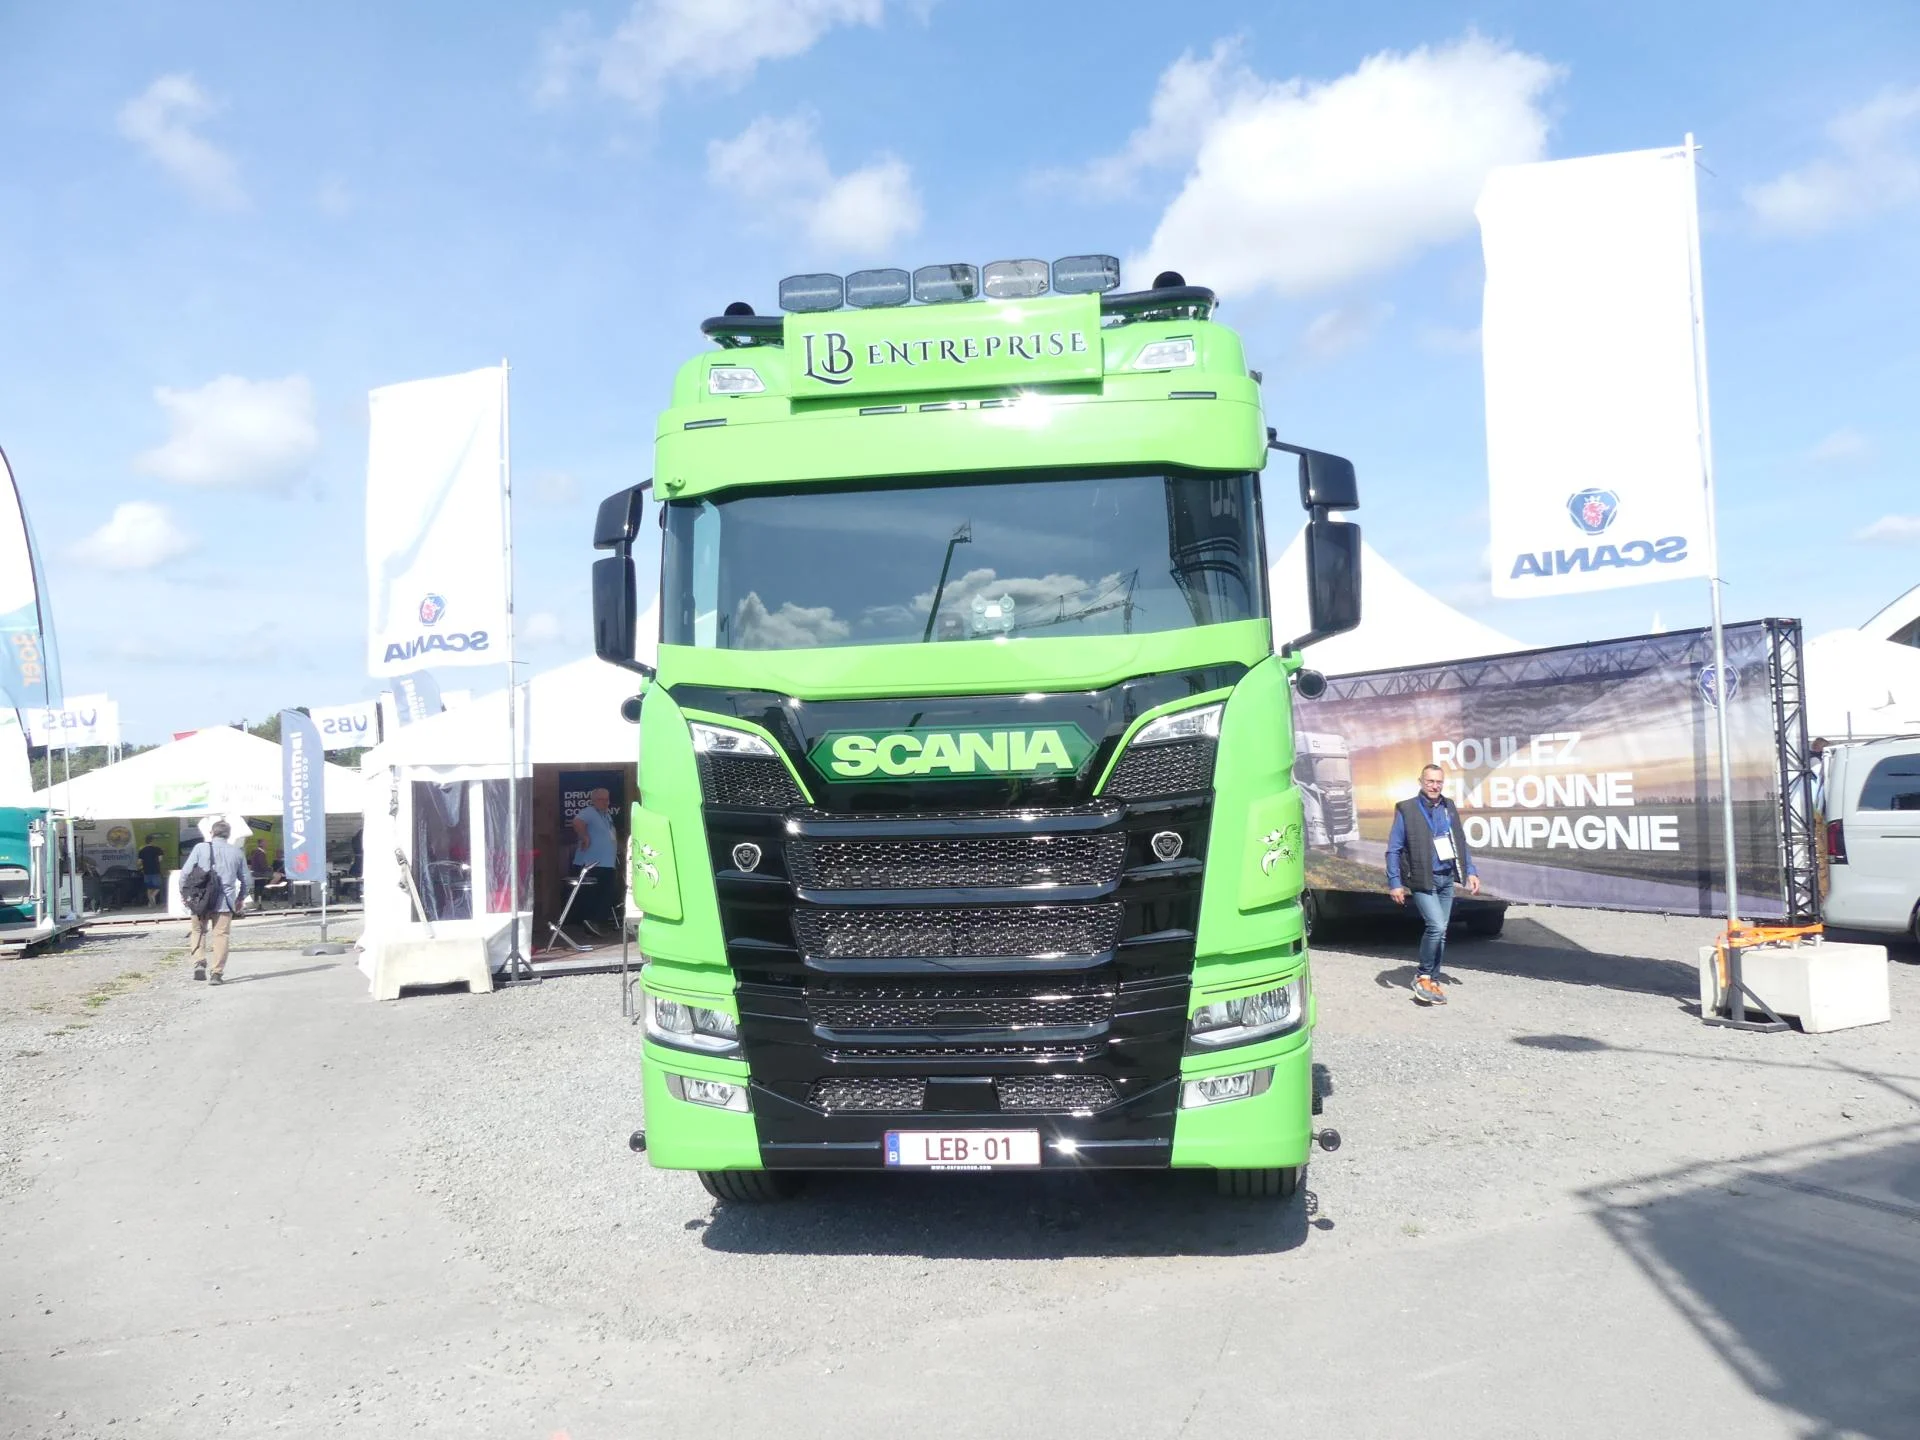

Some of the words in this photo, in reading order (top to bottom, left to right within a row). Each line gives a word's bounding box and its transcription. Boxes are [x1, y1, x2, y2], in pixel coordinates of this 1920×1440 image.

[803, 332, 854, 385] LB
[868, 331, 1088, 366] ENTREPRISE
[831, 730, 1074, 777] SCANIA
[1432, 731, 1582, 770] ROULEZ
[564, 791, 593, 799] DRIV
[564, 800, 576, 808] IN
[1490, 771, 1635, 808] BONNE
[1464, 815, 1680, 851] OMPAGNIE
[889, 1151, 898, 1162] B
[925, 1137, 1011, 1161] LEB-01
